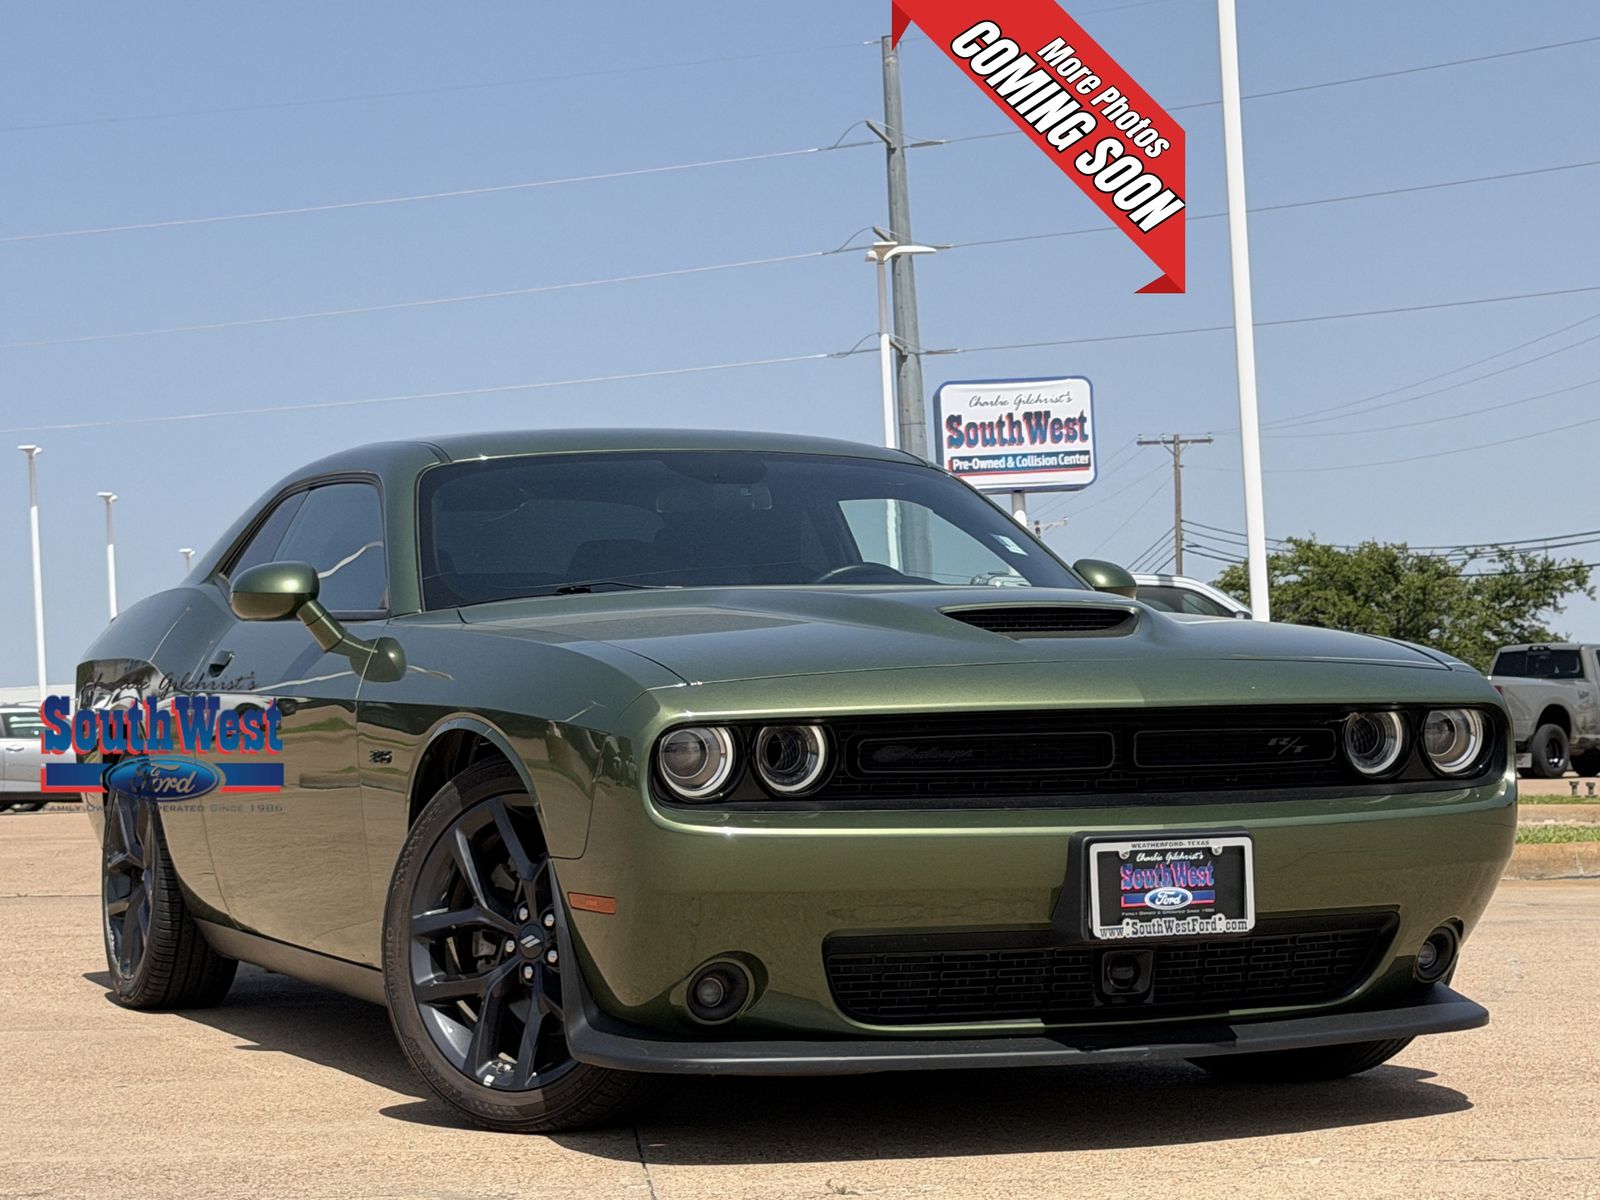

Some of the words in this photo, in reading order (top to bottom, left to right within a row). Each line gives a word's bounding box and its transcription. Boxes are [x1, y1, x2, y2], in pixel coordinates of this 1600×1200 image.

[968, 395, 1010, 408] Charlie
[1013, 391, 1073, 412] Gilchrist's
[945, 408, 1090, 449] SouthWest
[952, 458, 1006, 471] Pre-Owned
[1007, 456, 1015, 469] &
[1016, 454, 1058, 468] Collision
[1058, 453, 1091, 465] Center
[1121, 861, 1215, 890] SouthWest
[1155, 891, 1182, 905] Ford
